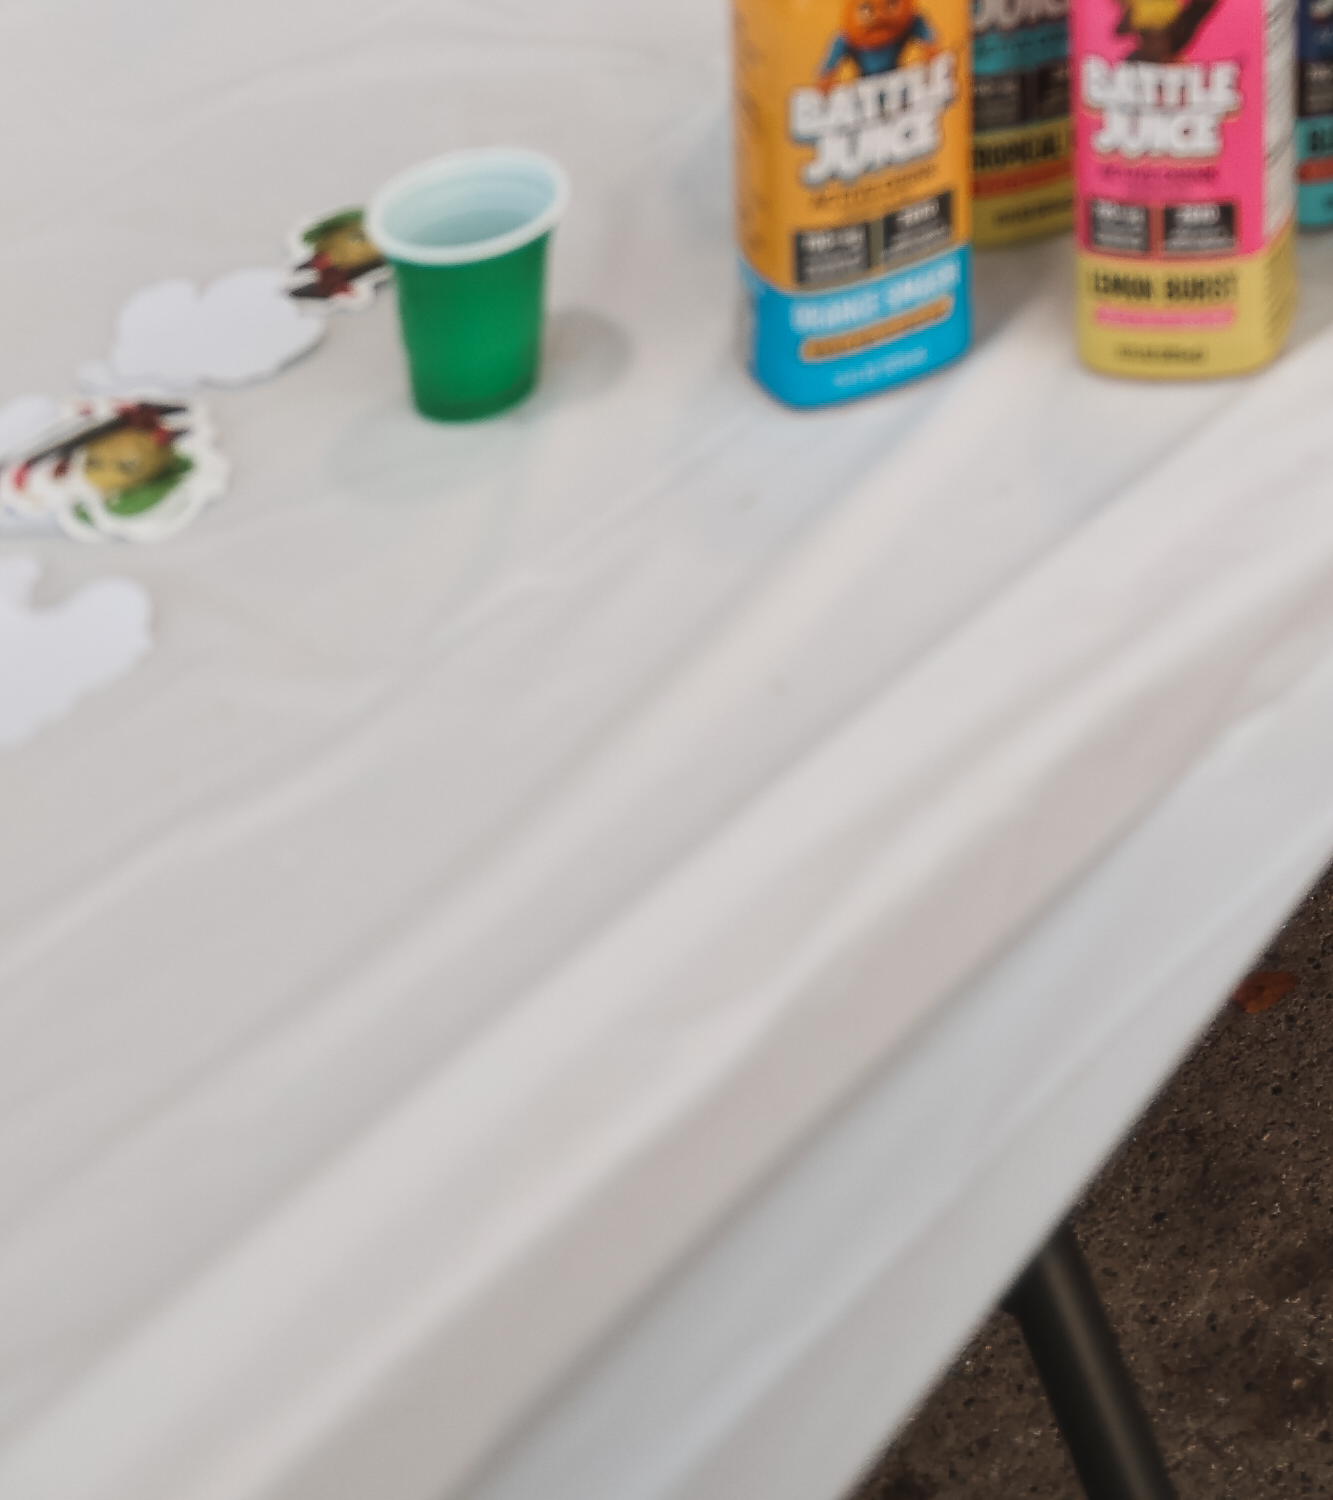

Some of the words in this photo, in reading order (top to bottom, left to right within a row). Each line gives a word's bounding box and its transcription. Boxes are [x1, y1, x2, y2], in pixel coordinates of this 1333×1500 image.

[789, 53, 956, 141] BATTLE
[1082, 58, 1240, 110] BATTLE
[804, 115, 940, 186] JUICE
[1093, 106, 1222, 157] JUICE
